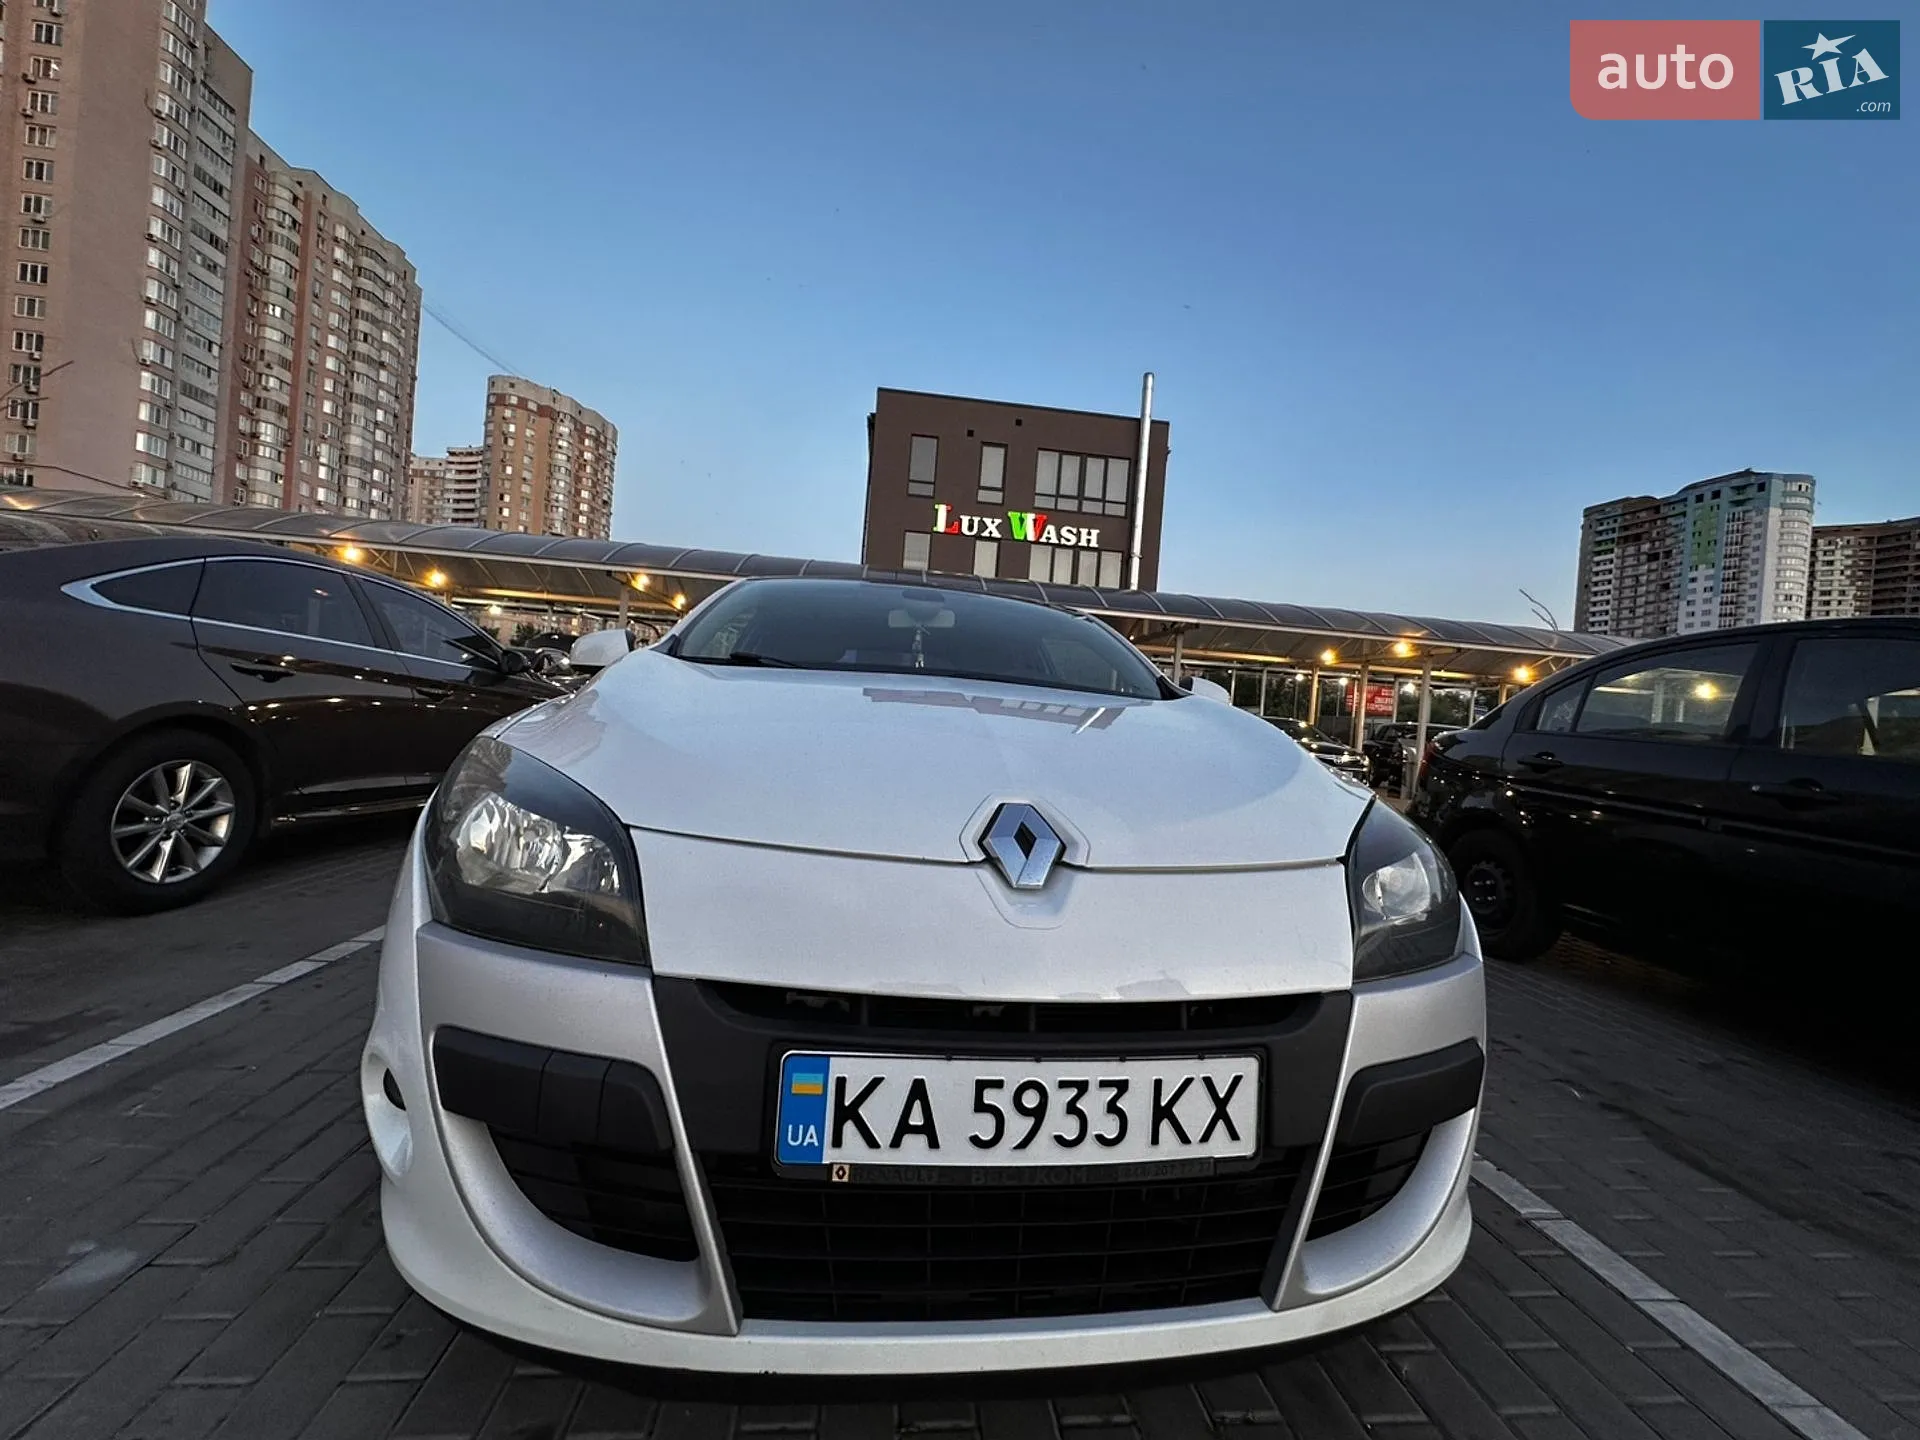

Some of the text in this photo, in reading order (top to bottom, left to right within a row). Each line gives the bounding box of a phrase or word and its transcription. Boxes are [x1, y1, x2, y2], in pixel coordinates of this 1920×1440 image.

[933, 503, 1100, 549] LUX WASH
[787, 1123, 819, 1148] UA
[831, 1074, 1244, 1151] KA 5933 KX
